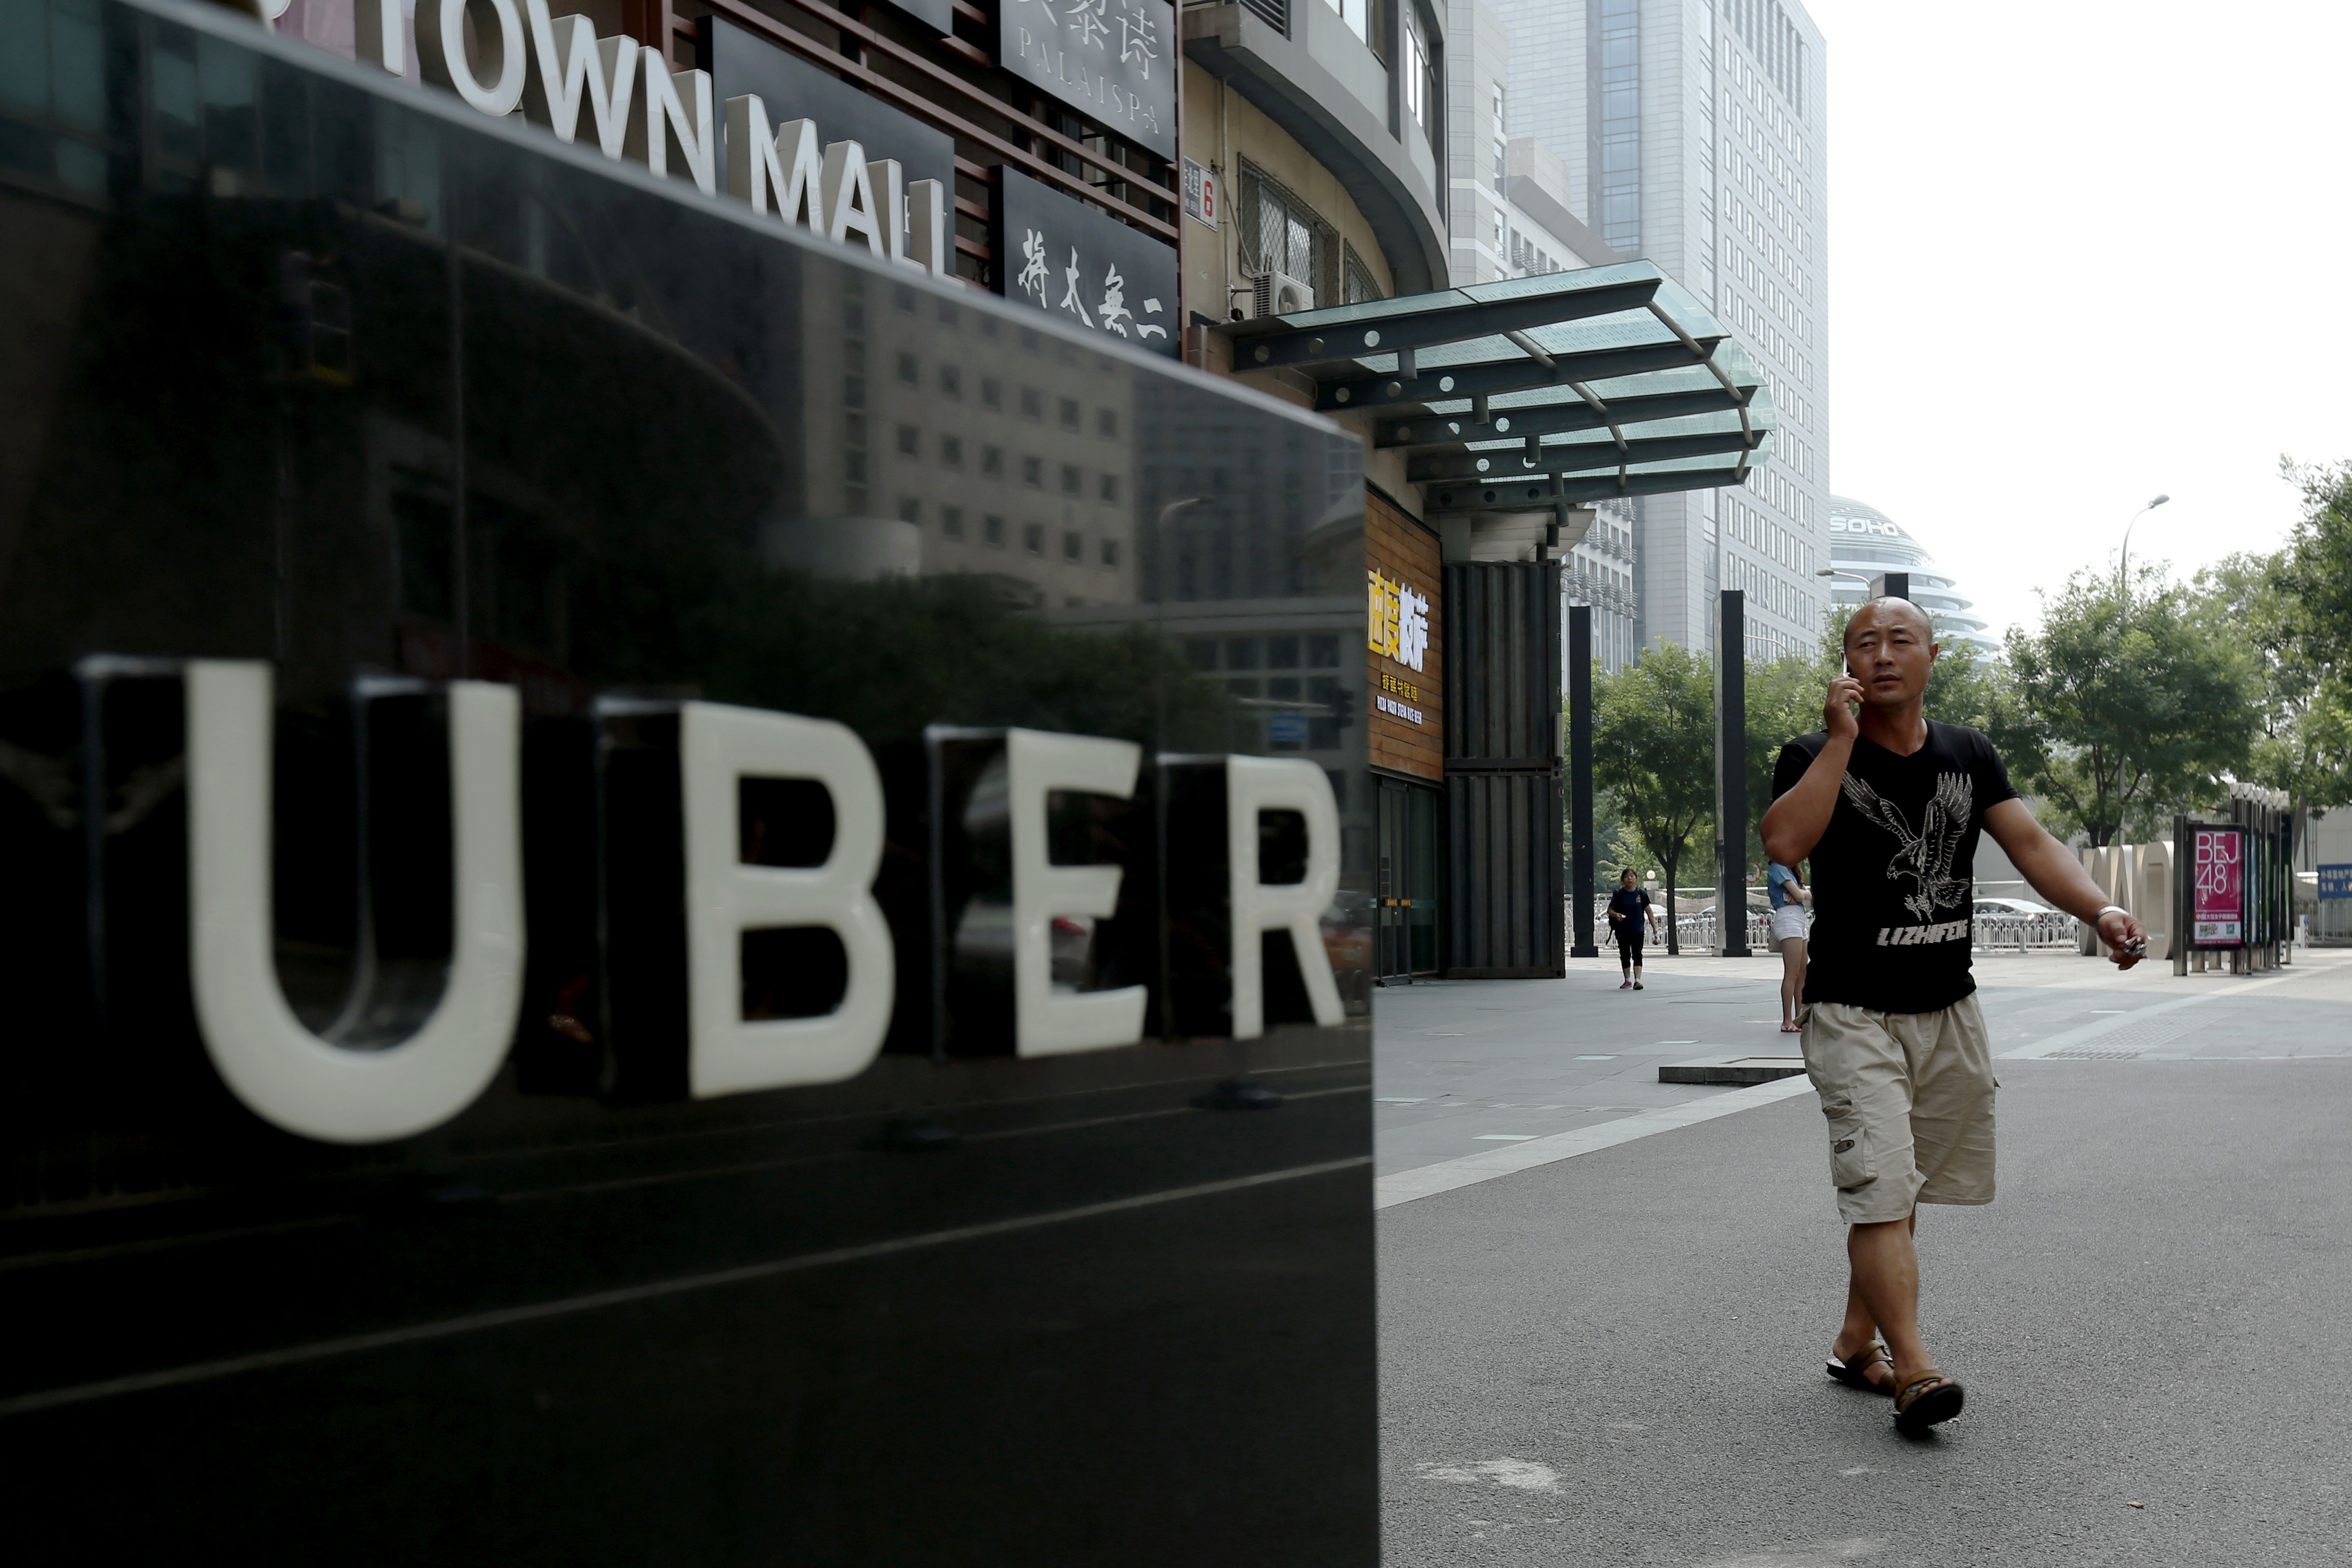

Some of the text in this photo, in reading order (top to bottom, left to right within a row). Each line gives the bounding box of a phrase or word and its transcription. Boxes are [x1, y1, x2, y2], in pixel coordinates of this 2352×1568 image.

[748, 93, 966, 291] MALL
[1204, 180, 1213, 217] 6
[1830, 517, 1899, 537] SOHO
[2196, 833, 2238, 864] BEJ
[2196, 864, 2227, 894] 48
[186, 659, 1345, 1144] UBER
[1876, 919, 1968, 946] LIZHIFENG
